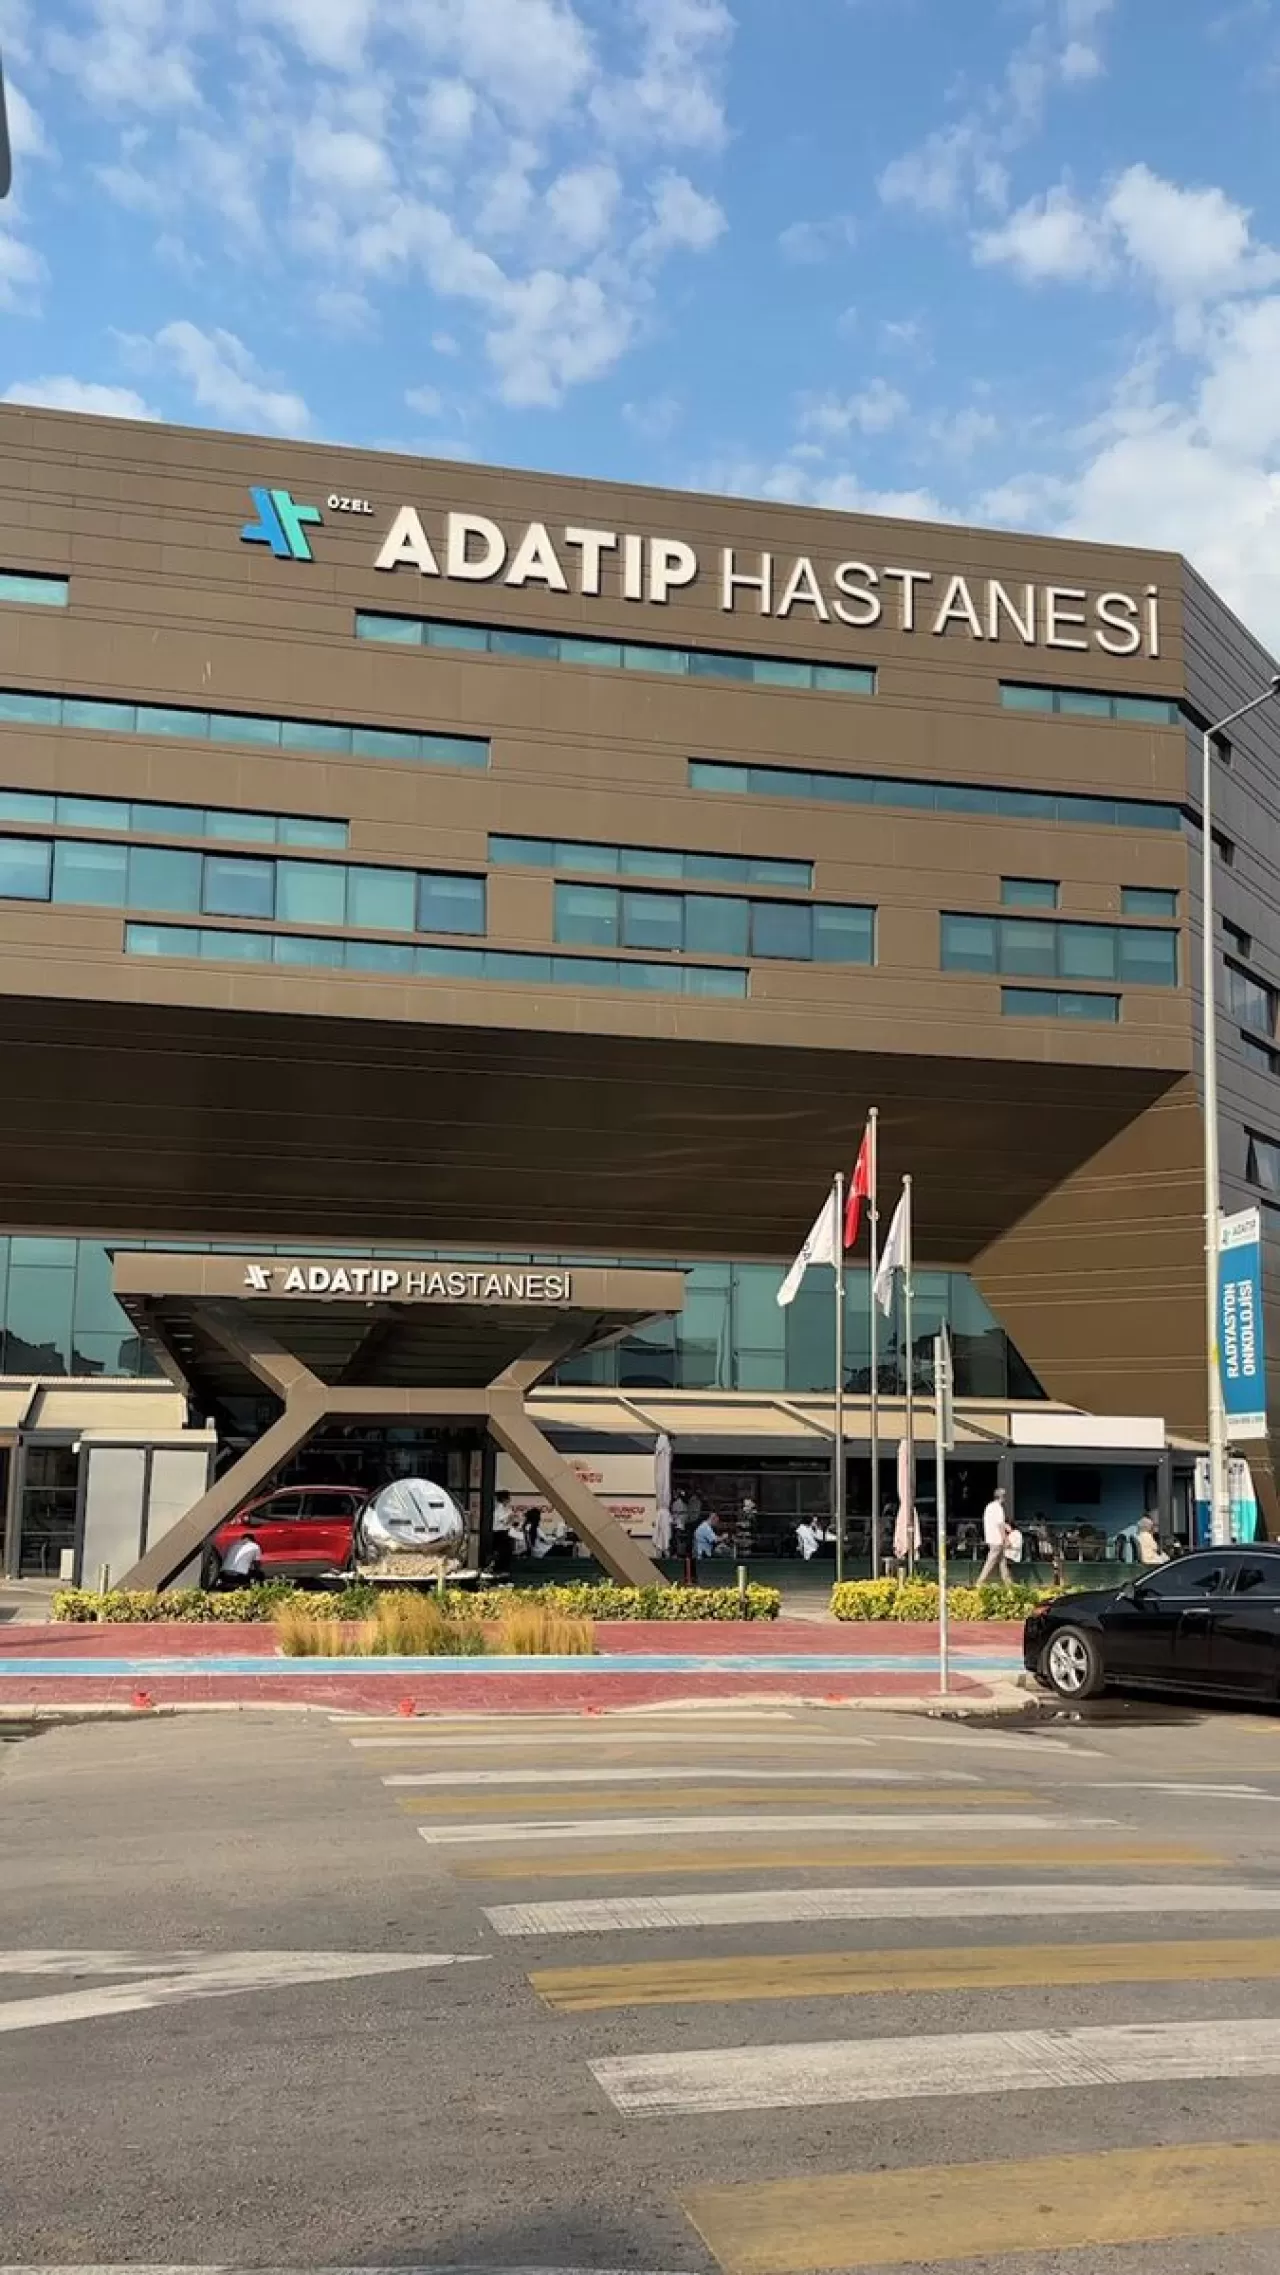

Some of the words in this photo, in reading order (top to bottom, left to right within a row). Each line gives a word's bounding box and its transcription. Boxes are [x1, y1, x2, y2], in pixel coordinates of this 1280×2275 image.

[328, 494, 373, 513] ÖZEL
[374, 505, 697, 602] ADATIP
[721, 547, 1160, 658] HASTANESİ
[284, 1265, 399, 1294] ADATIP
[406, 1270, 572, 1299] HASTANESİ
[1224, 1282, 1239, 1378] RADYASYON
